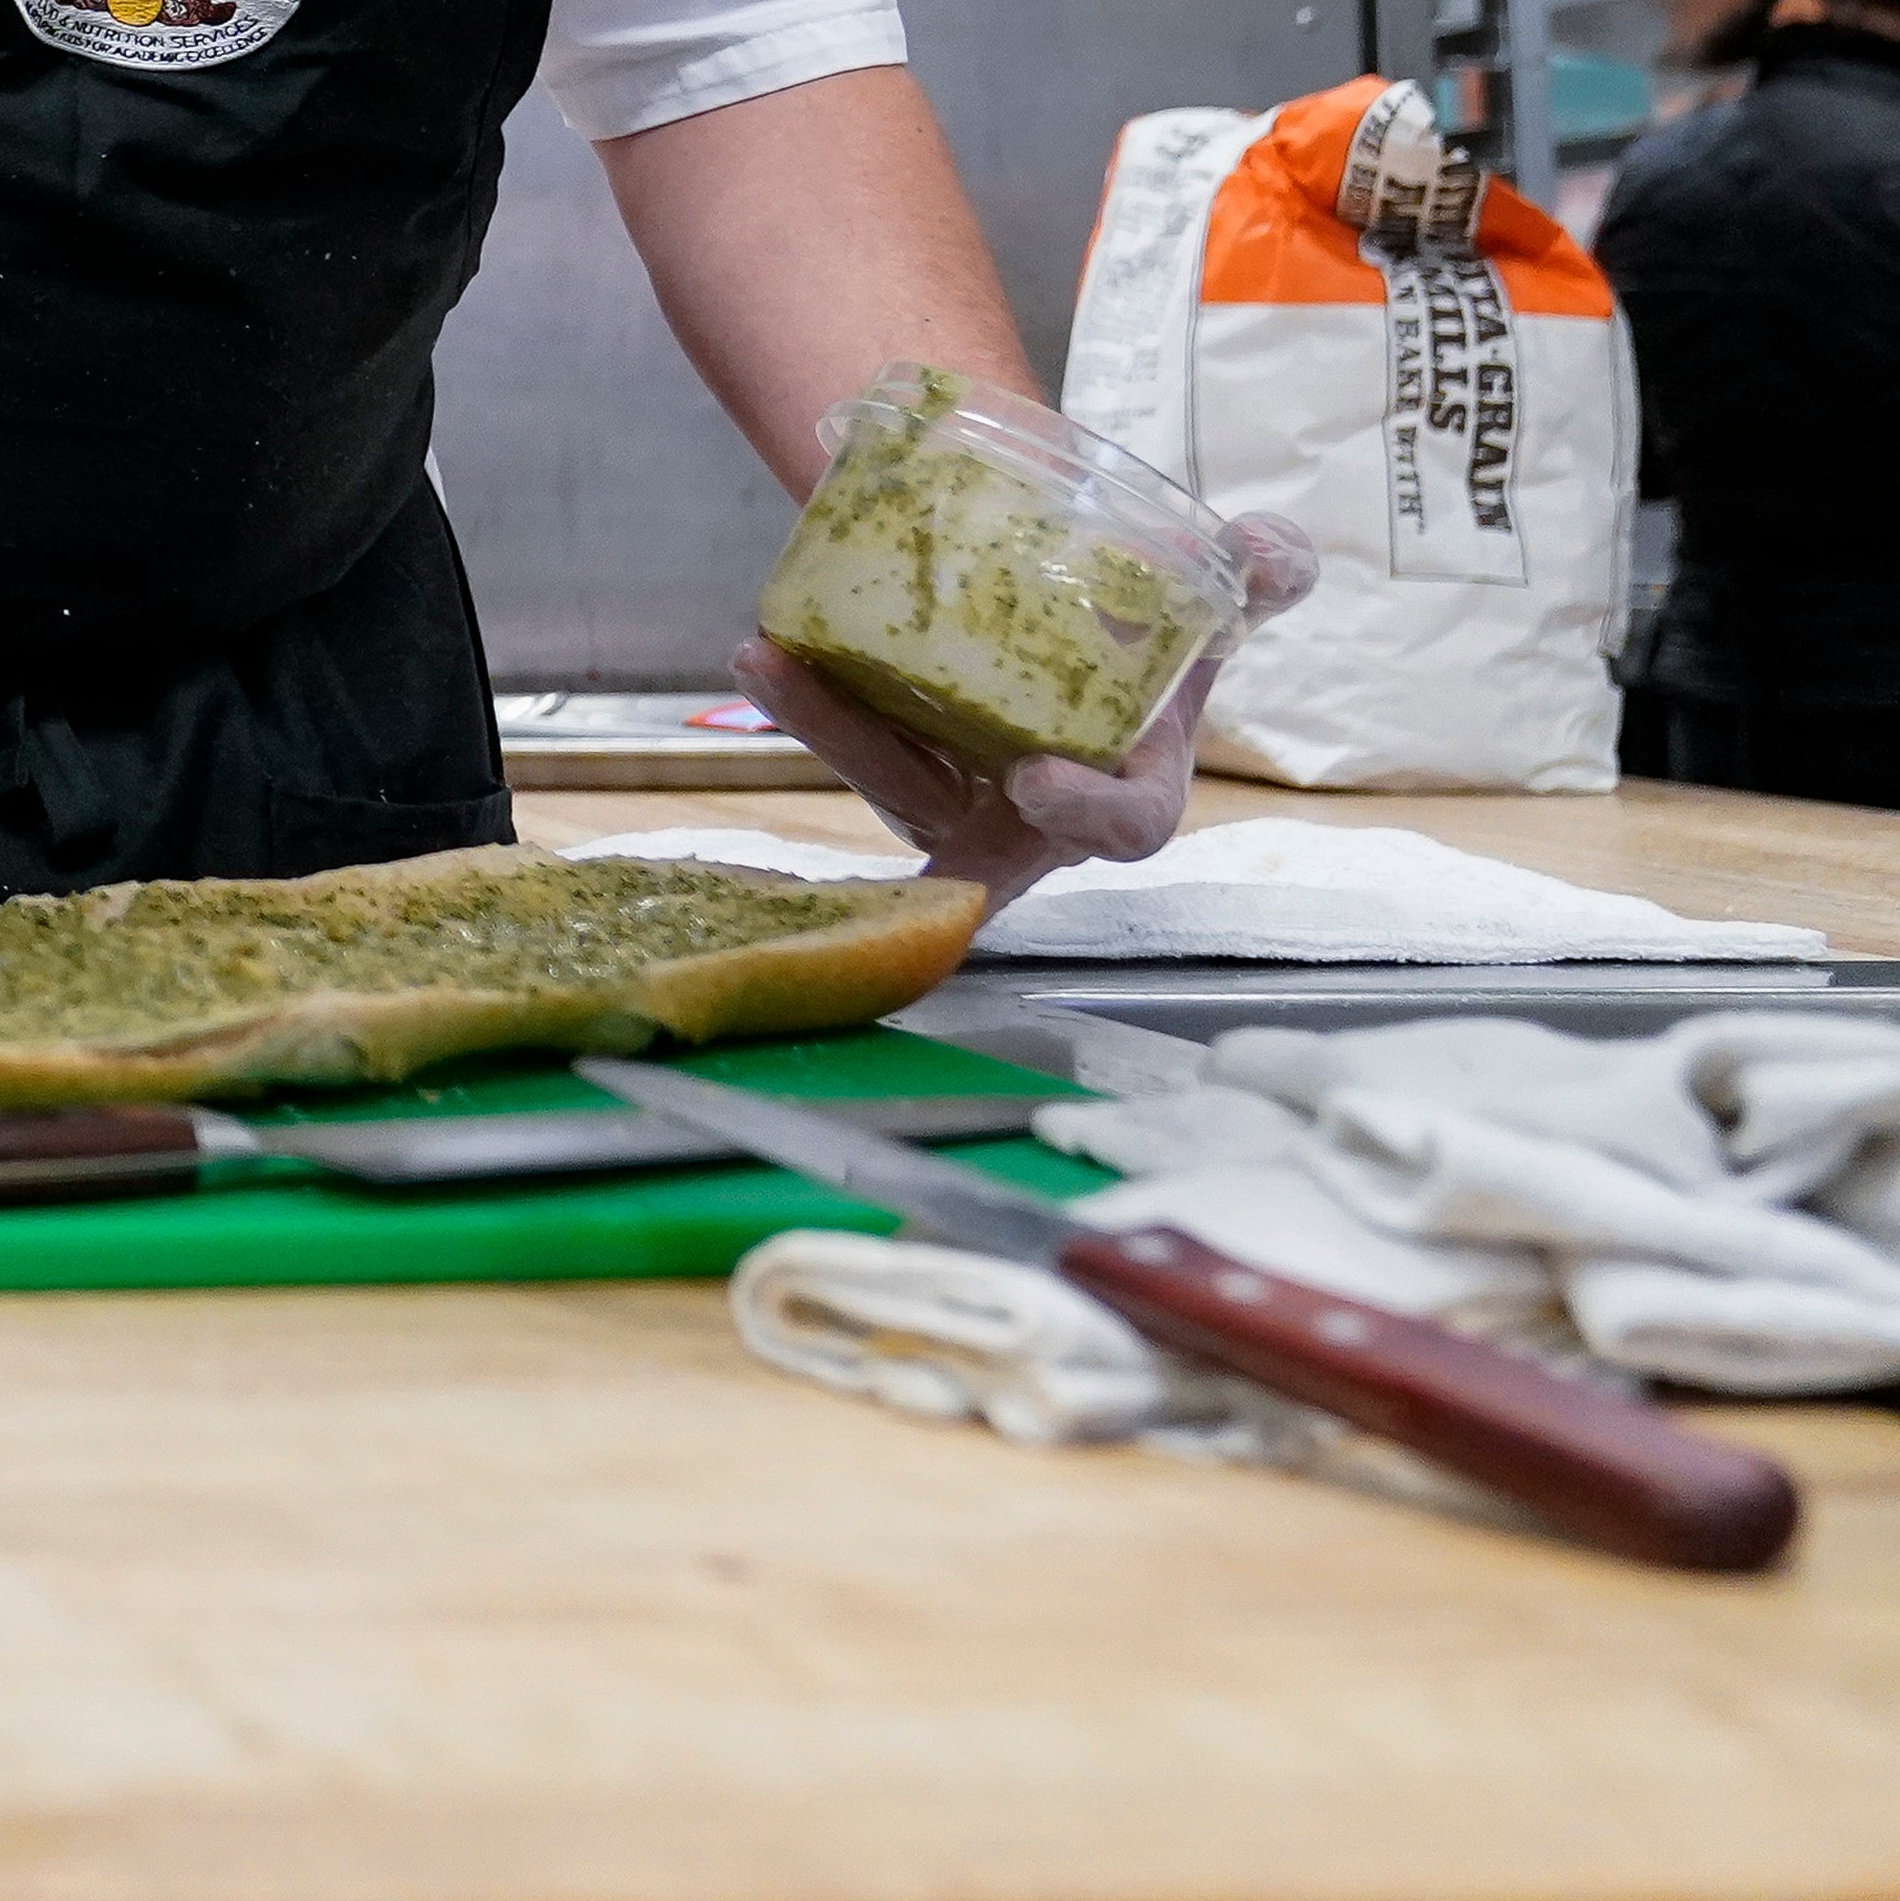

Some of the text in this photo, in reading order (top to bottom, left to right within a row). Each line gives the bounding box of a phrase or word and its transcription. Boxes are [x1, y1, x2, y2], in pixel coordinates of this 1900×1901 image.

[71, 20, 165, 47] NUTRITION
[170, 14, 259, 49] SERVICES
[1420, 266, 1467, 435] MILLS
[1470, 364, 1521, 532] GRAIN
